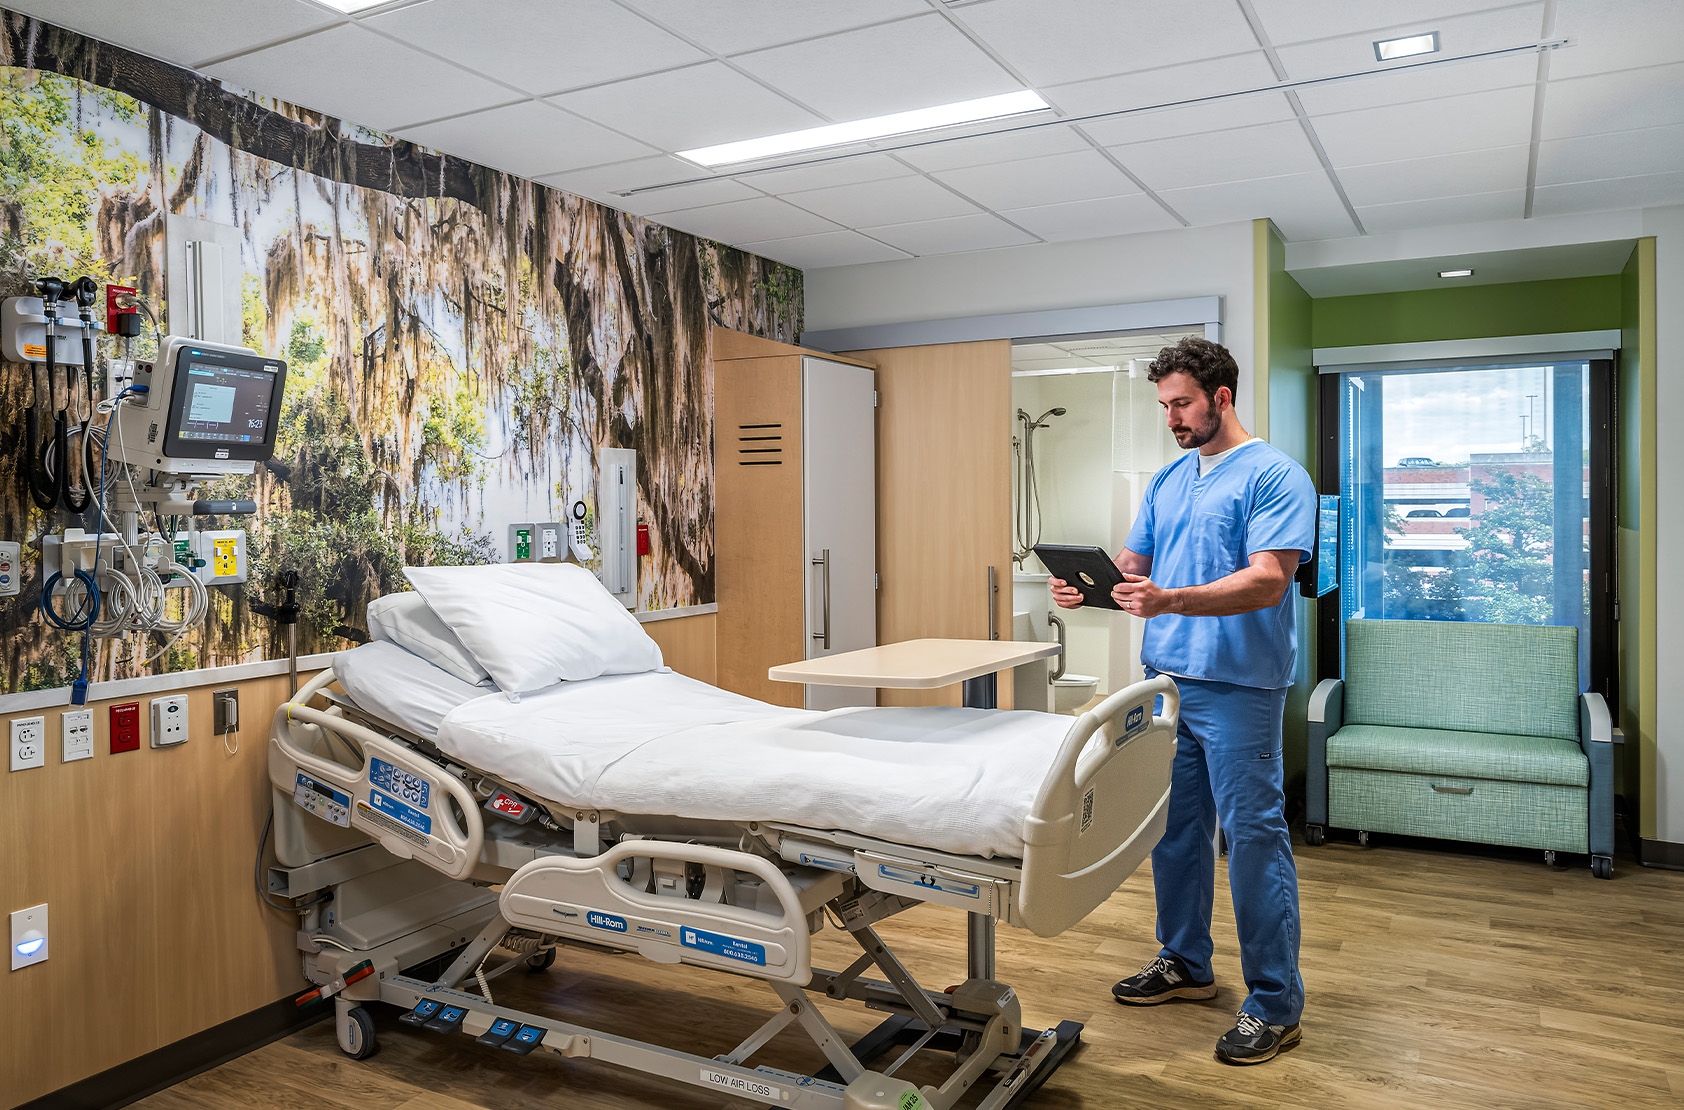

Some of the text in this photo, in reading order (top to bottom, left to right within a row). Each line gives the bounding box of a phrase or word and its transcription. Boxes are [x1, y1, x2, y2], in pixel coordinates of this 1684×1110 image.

[504, 798, 518, 808] CPR
[590, 914, 624, 929] Hill-Rom
[732, 941, 748, 949] Rental
[709, 1072, 770, 1096] LOW AIR LOSS
[909, 1093, 919, 1104] 25
